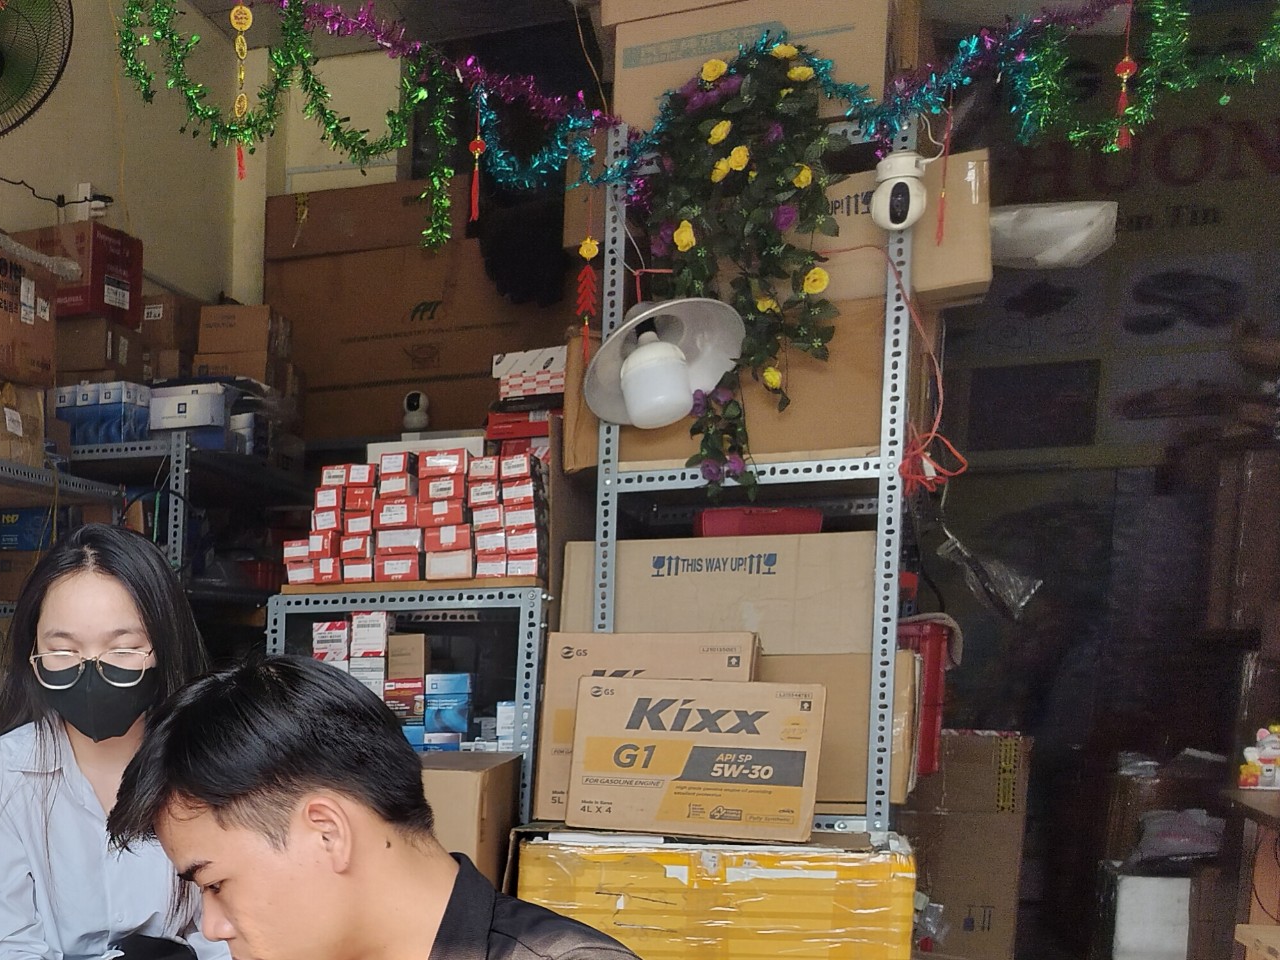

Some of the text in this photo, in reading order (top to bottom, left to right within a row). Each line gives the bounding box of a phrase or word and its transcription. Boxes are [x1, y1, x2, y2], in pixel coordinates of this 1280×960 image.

[680, 556, 747, 573] THIS WAY UP!
[624, 697, 770, 736] Kixx
[613, 743, 657, 769] G1
[716, 753, 753, 763] API SP
[710, 763, 774, 780] 5W-30
[634, 779, 661, 787] ENGINE
[551, 796, 564, 804] 5L
[580, 805, 592, 813] 4L
[605, 806, 612, 814] 4
